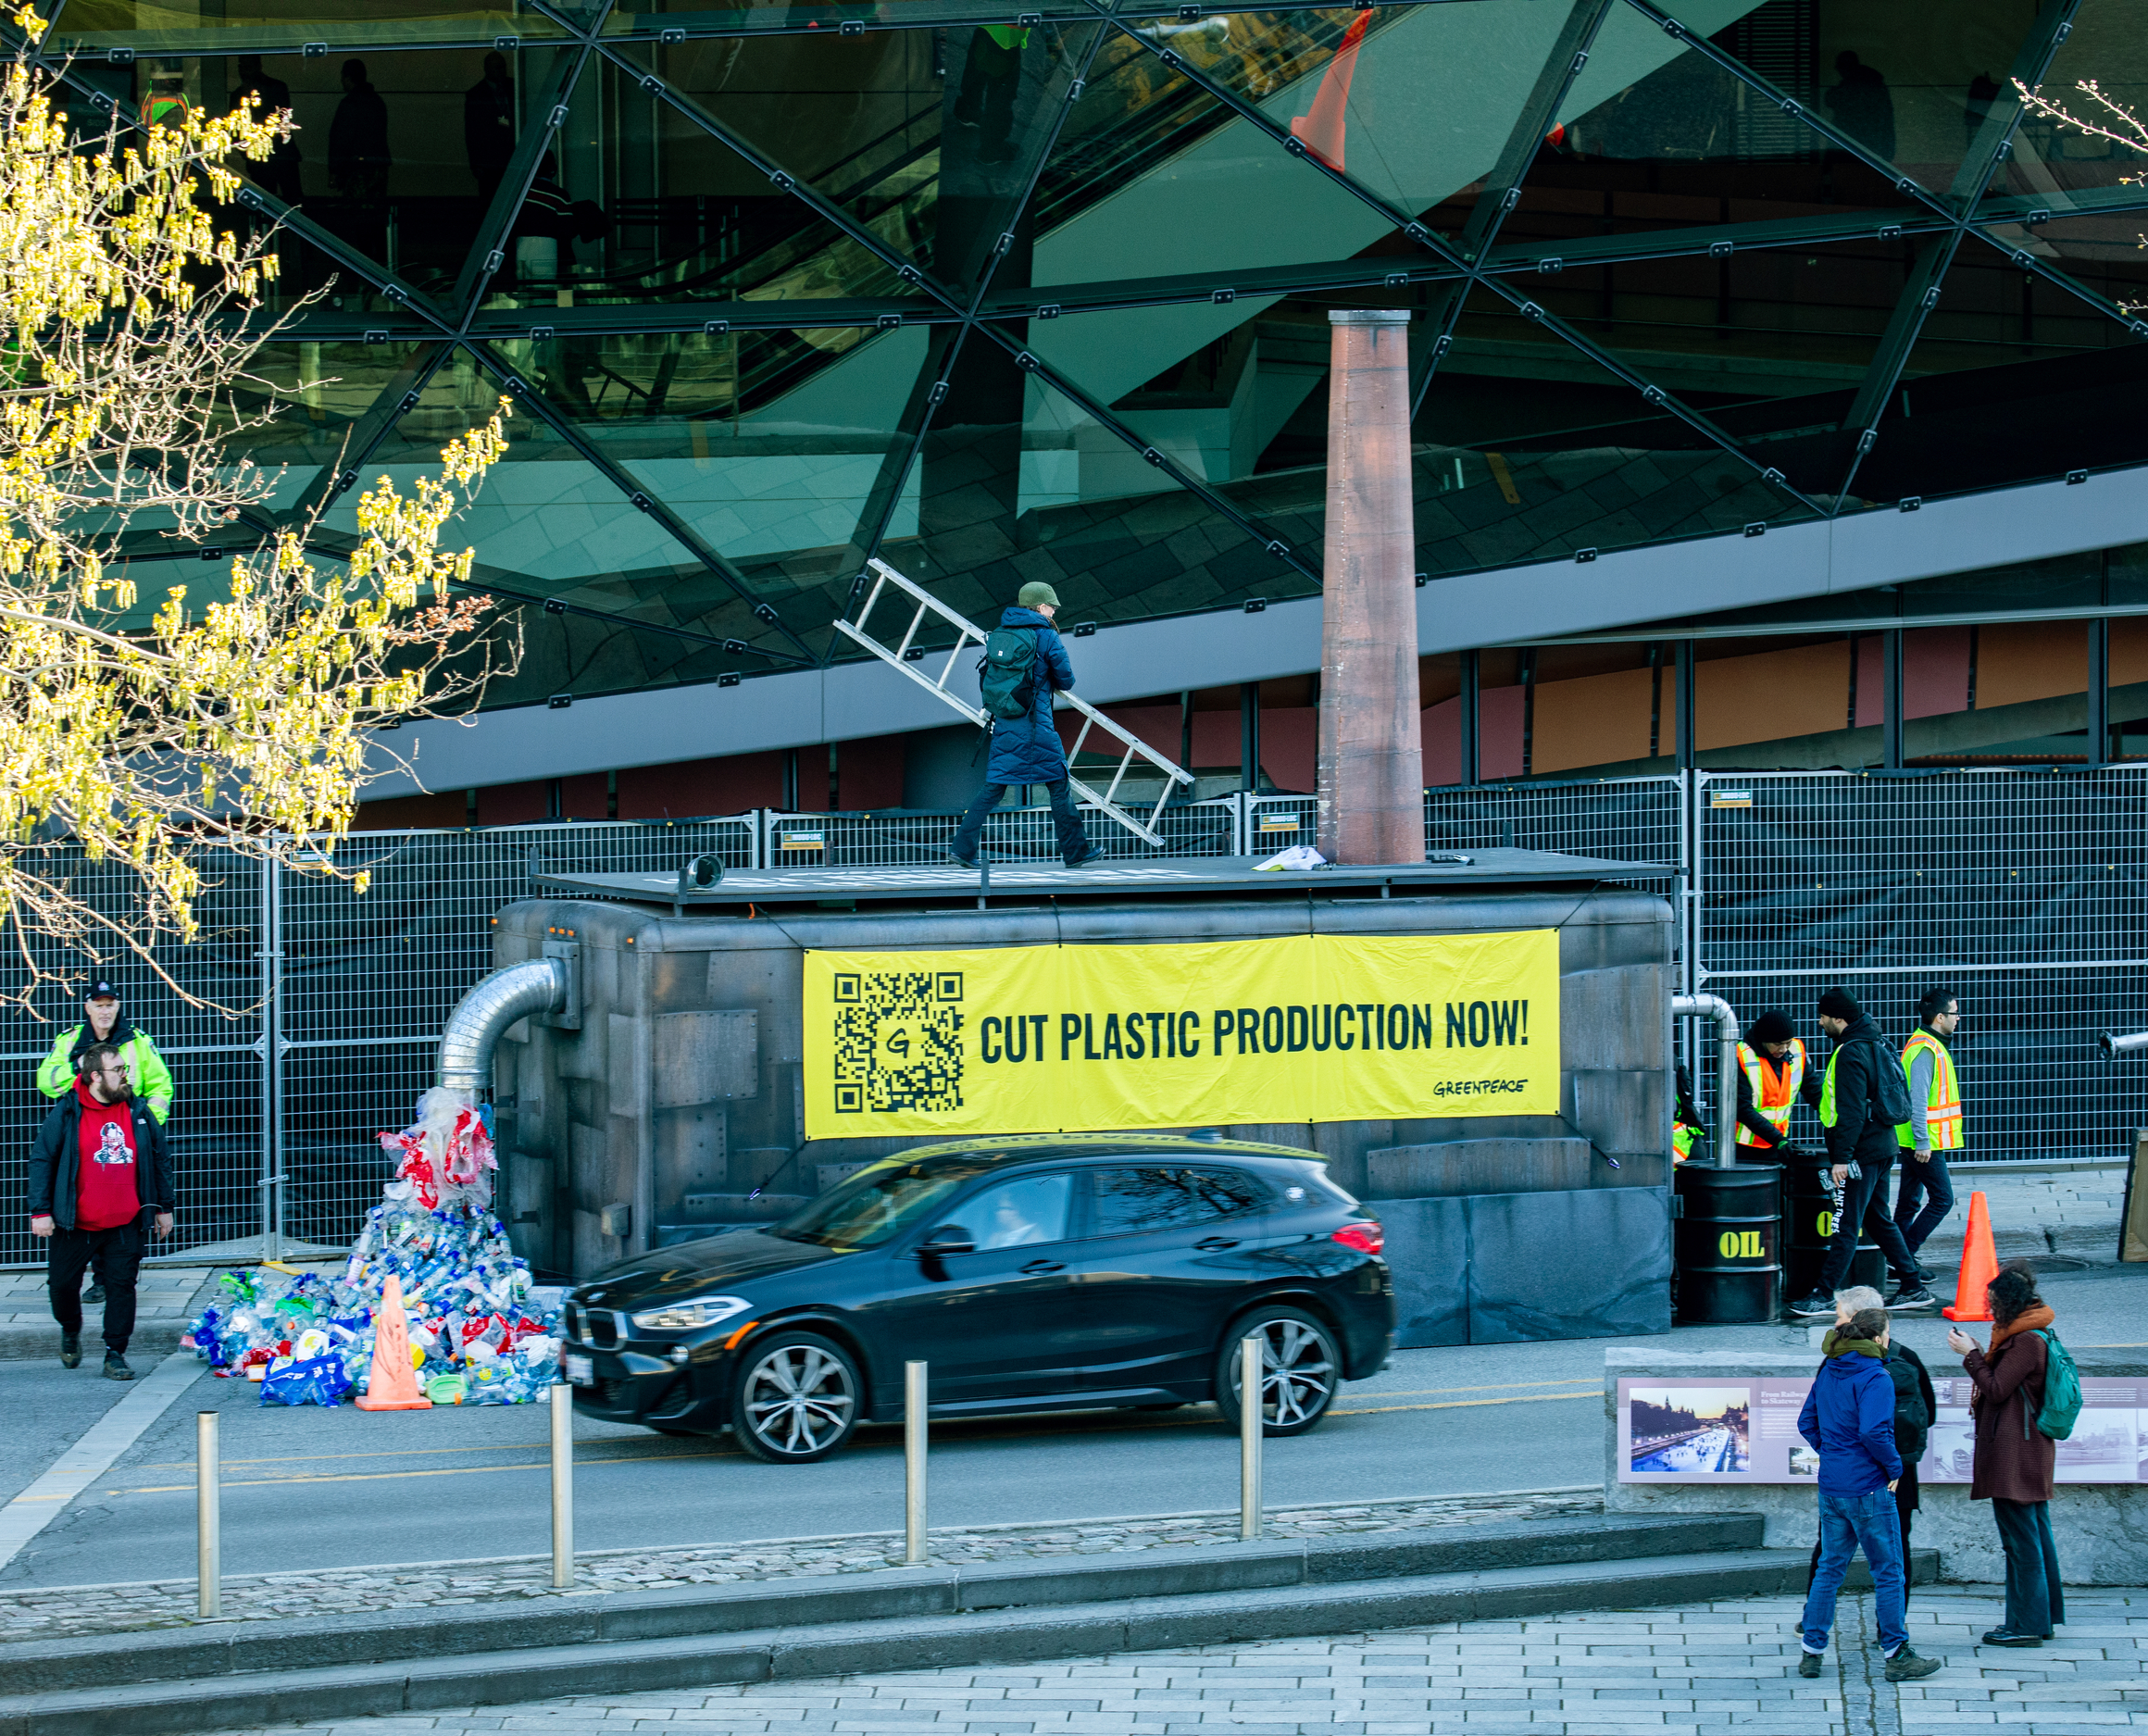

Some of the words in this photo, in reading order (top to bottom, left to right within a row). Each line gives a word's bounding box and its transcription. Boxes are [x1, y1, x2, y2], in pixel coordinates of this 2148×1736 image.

[981, 1014, 1047, 1063] CUT
[1062, 1010, 1199, 1060] PLASTIC
[1215, 1003, 1431, 1055] PRODUCTION
[1446, 1000, 1528, 1047] NOW!
[1433, 1079, 1529, 1098] GREENPEACE
[1830, 1208, 1844, 1233] TREES
[1719, 1230, 1765, 1258] OIL
